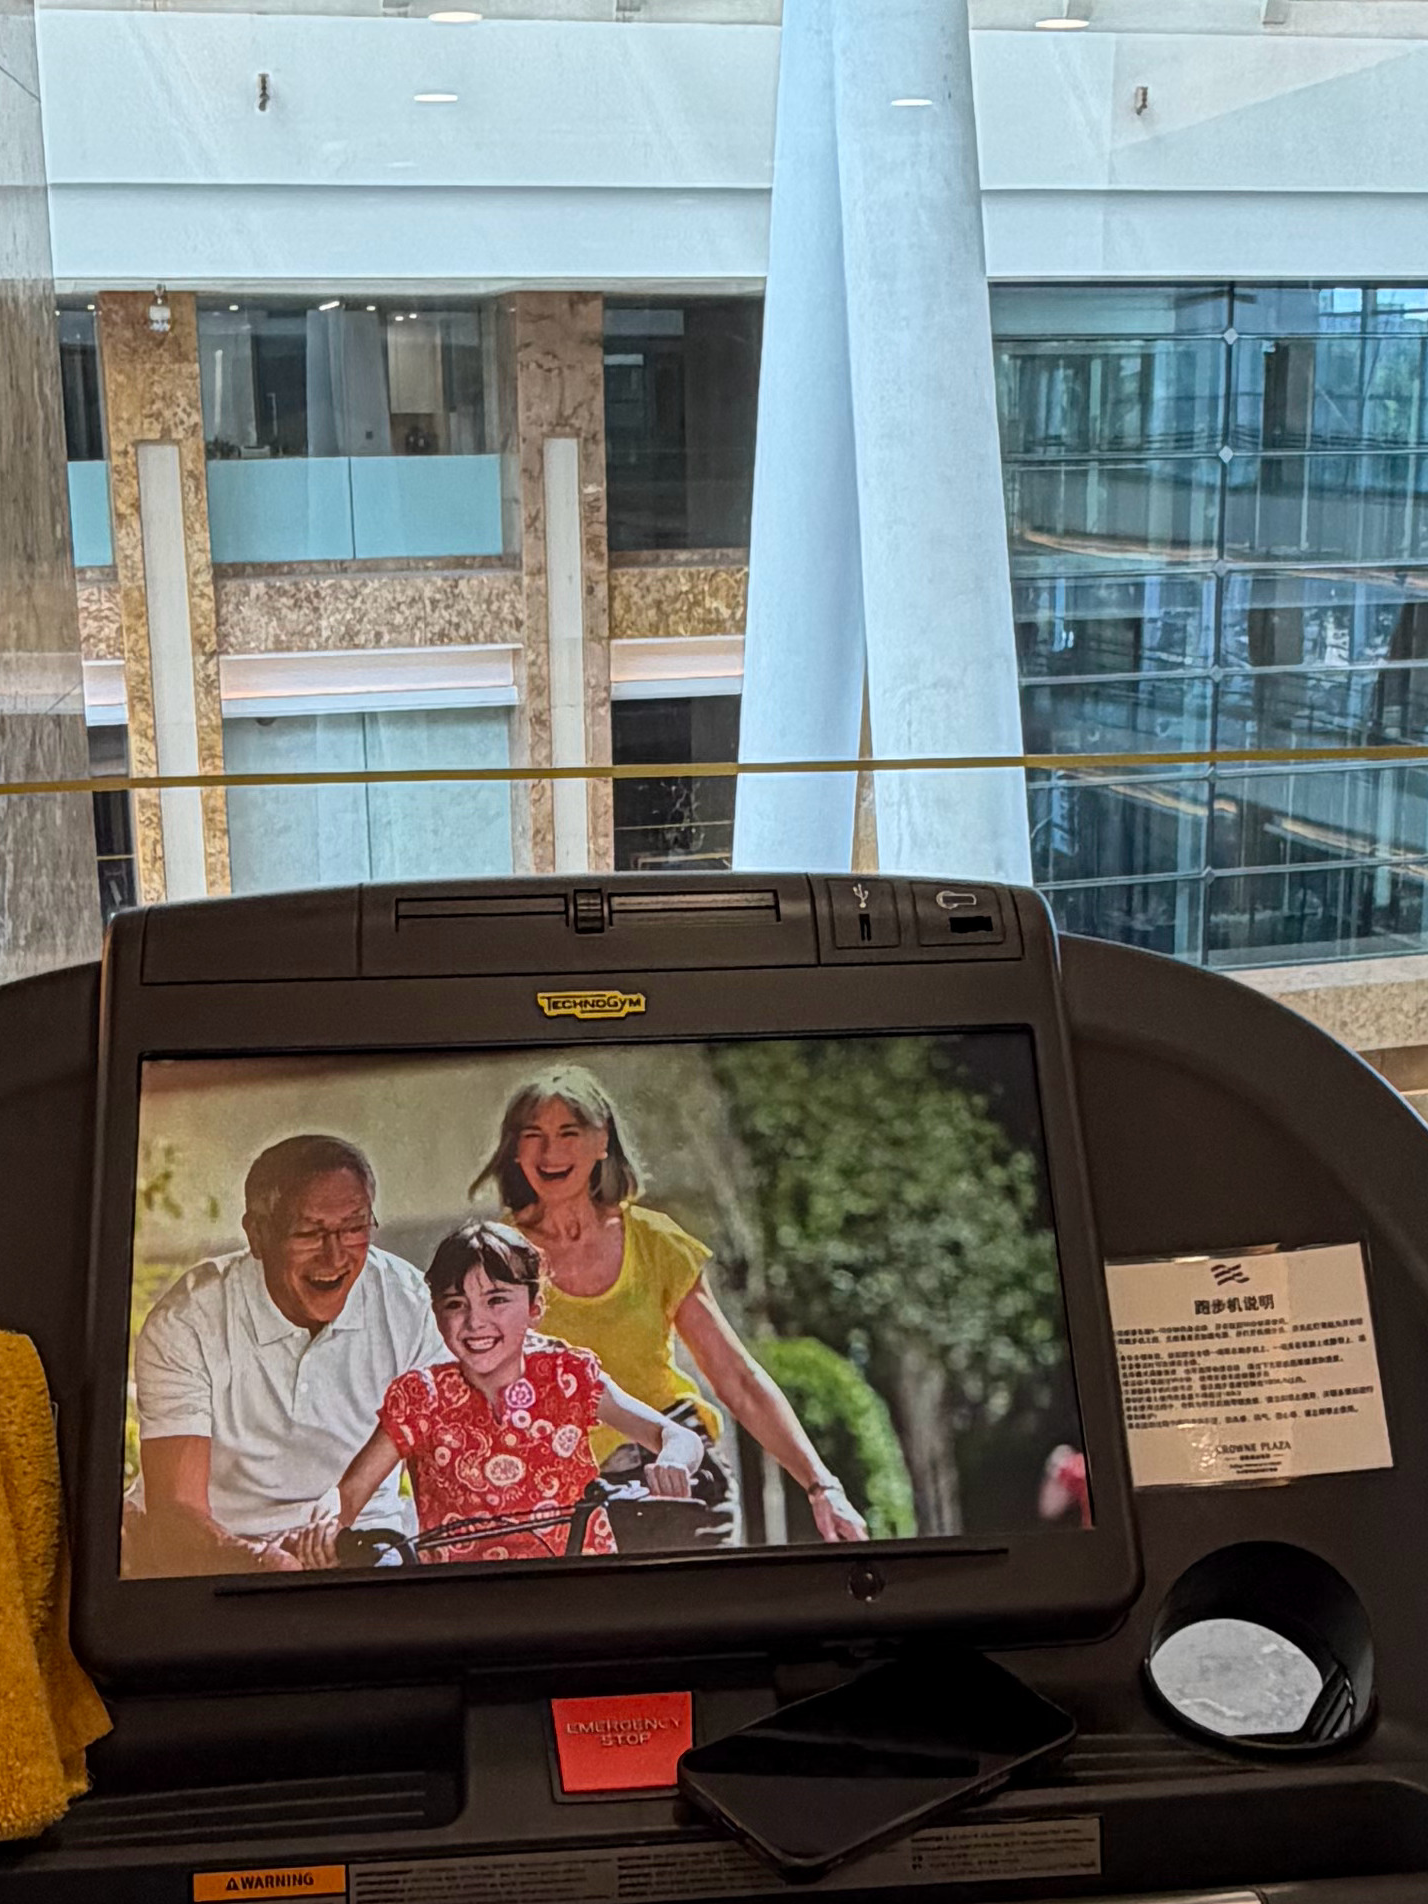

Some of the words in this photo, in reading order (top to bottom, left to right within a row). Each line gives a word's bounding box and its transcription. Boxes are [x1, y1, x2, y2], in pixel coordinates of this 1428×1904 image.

[1194, 1294, 1275, 1315] 跑步机说明
[1260, 1440, 1292, 1451] PLAZA
[566, 1717, 680, 1735] EMERGENCY
[601, 1731, 652, 1747] STOP
[240, 1872, 315, 1890] WARNING
